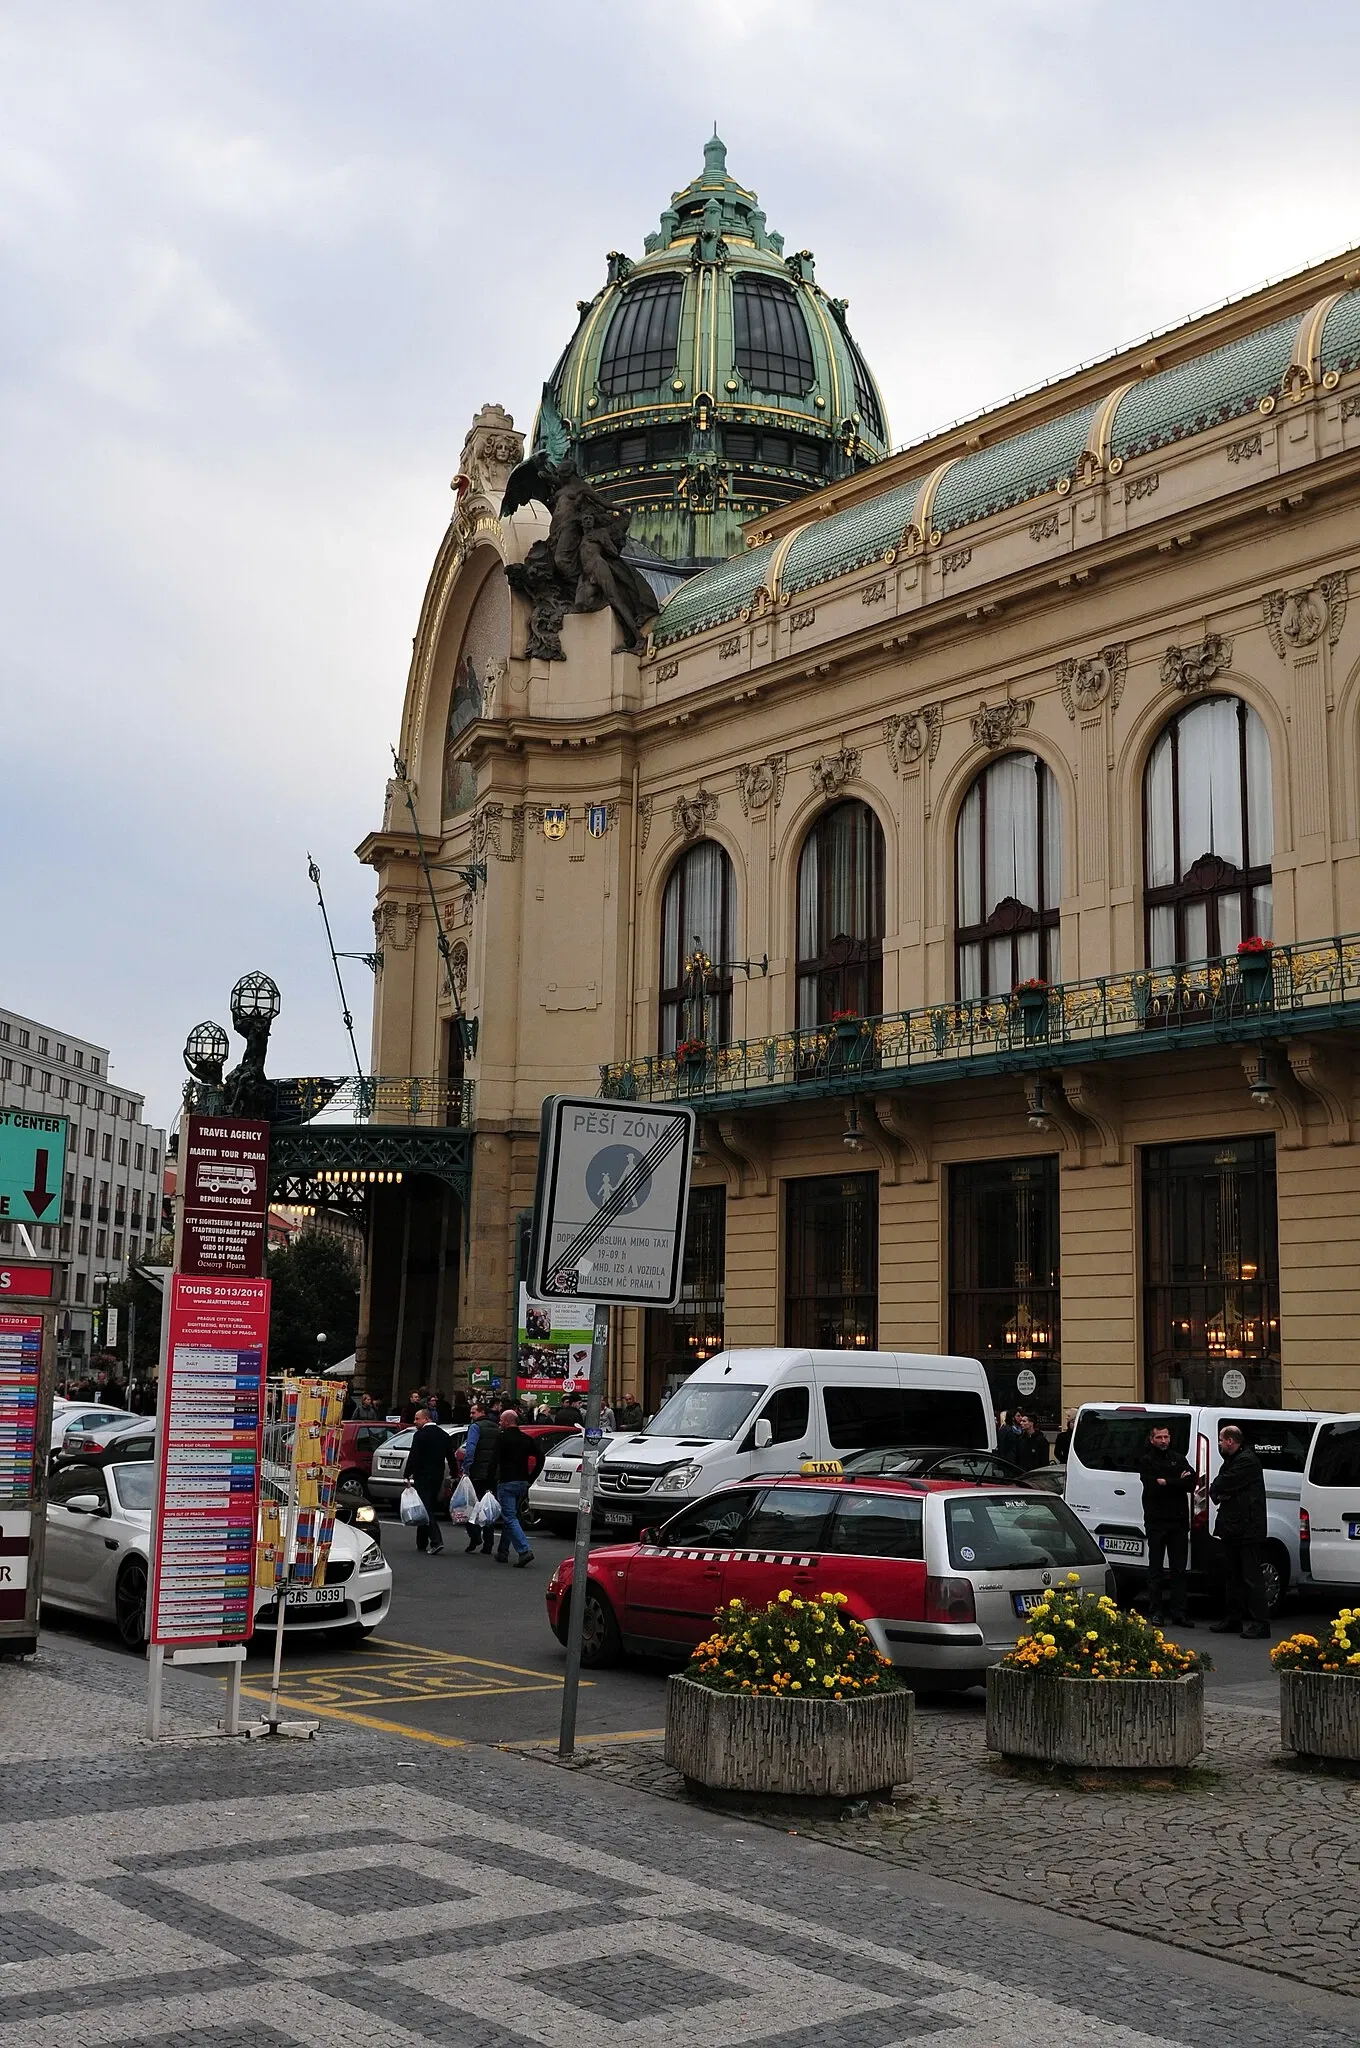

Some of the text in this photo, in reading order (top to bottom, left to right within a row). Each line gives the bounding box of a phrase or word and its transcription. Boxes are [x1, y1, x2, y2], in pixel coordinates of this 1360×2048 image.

[14, 1114, 60, 1132] CENTER
[573, 1112, 617, 1135] PĚŠÍ
[199, 1127, 262, 1140] TRAVEL AGENCY
[190, 1147, 266, 1160] MARTIN TOUR PRAHA
[200, 1195, 252, 1205] REPUBLIC SQUARE
[199, 1218, 233, 1227] SIGHTSEEING
[242, 1221, 263, 1229] PRAGUE
[192, 1226, 256, 1237] STADTRUNDFAHRT PRAG
[200, 1235, 217, 1243] VISITE
[226, 1237, 248, 1245] PRAGUE
[630, 1238, 650, 1248] MIMO
[653, 1239, 669, 1248] TAXI
[598, 1249, 627, 1260] 19-09 h
[197, 1260, 247, 1270] Осмотр Праги
[613, 1263, 625, 1273] IZS
[628, 1264, 634, 1274] A
[637, 1265, 665, 1276] VOZIDLA
[616, 1276, 627, 1288] MČ
[630, 1278, 654, 1289] PRAHA
[658, 1281, 662, 1289] 1
[180, 1286, 264, 1298] TOURS 2013/2014
[563, 1381, 574, 1390] 500
[812, 1463, 838, 1472] TAXI
[1105, 1539, 1140, 1551] 3AH 7273
[289, 1589, 340, 1603] 3AS 0939
